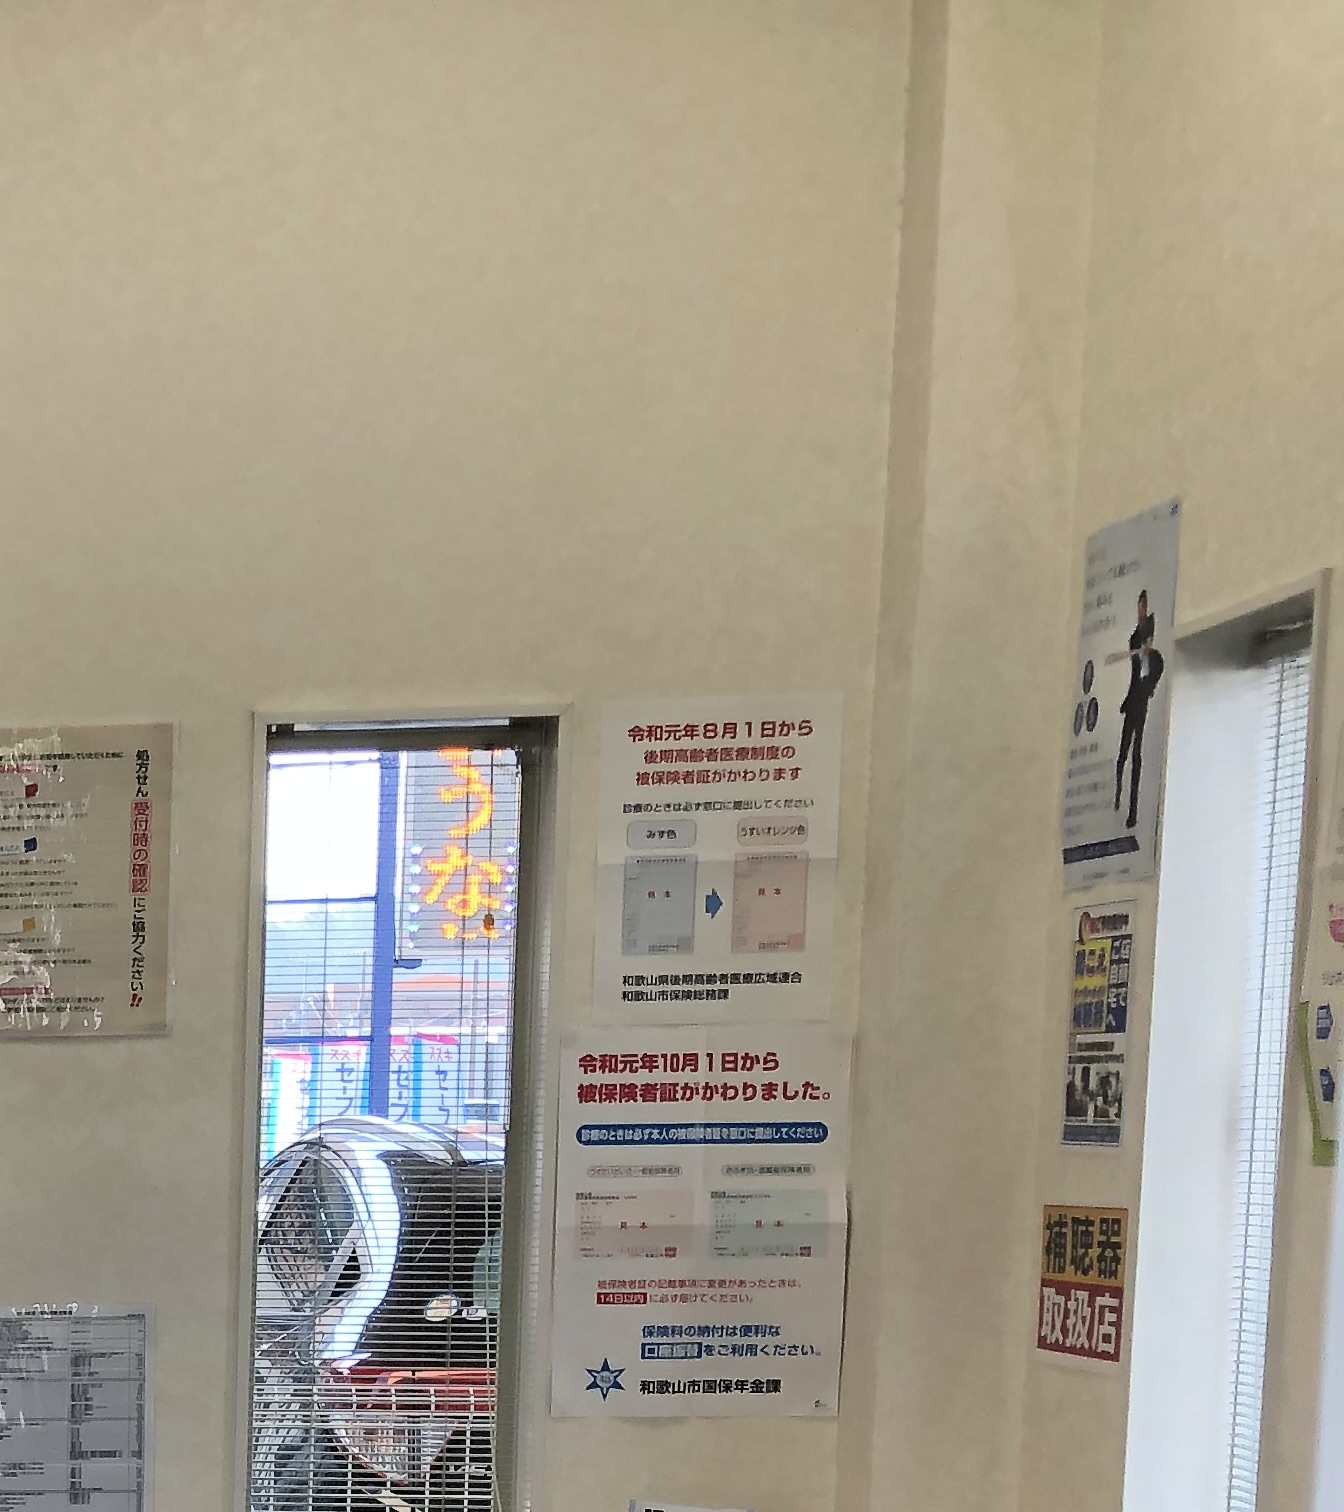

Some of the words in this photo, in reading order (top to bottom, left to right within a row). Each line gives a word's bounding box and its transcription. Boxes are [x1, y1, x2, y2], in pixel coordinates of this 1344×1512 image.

[627, 719, 814, 742] 令和元年8月1日から
[644, 745, 796, 765] 後期高齢者医療制度の
[635, 767, 803, 786] 被保険者証がかわります
[578, 1051, 780, 1075] 令和元年10月1日から
[577, 1081, 832, 1104] 被保険者証がかわりました。
[1041, 1287, 1120, 1355] 取扱店
[639, 1379, 783, 1395] 和歌山市国保年金課
